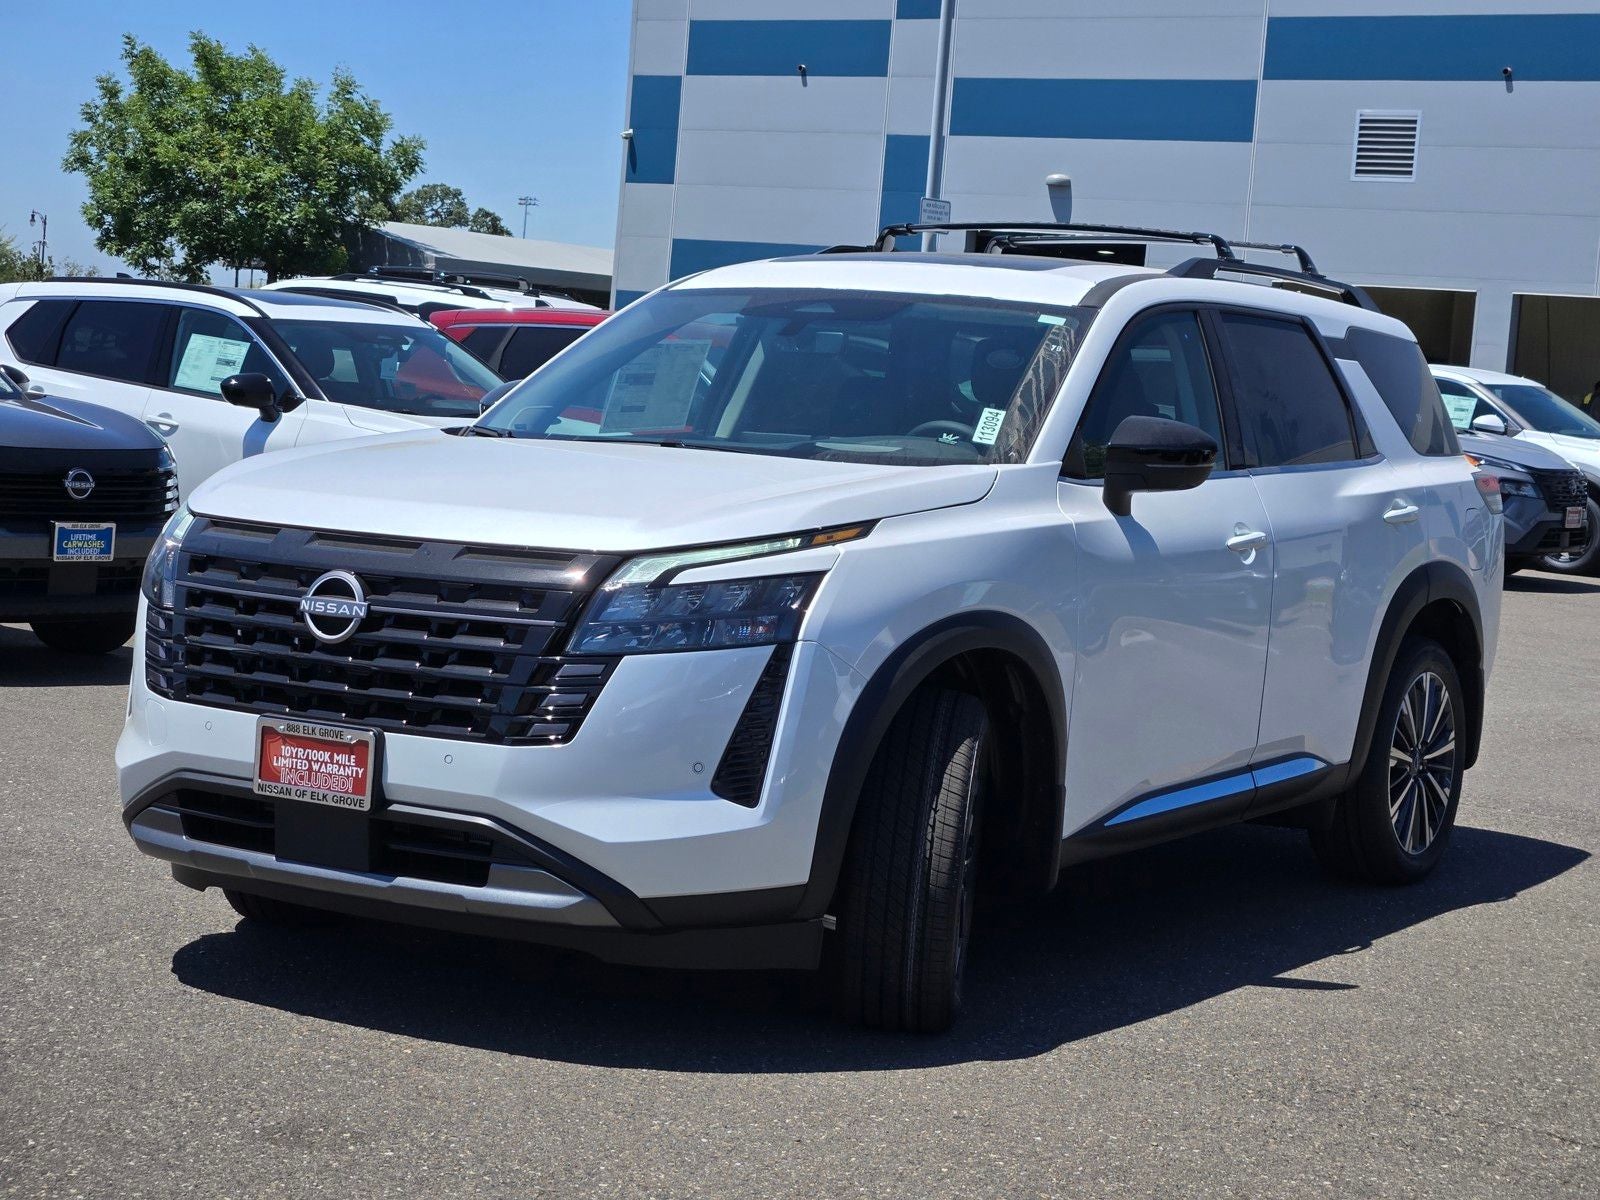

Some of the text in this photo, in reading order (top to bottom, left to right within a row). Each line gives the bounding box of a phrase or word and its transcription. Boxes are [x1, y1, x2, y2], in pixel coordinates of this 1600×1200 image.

[978, 410, 1002, 441] 113094
[62, 540, 105, 548] CARWASHES
[70, 533, 97, 541] LIFETIME
[67, 547, 101, 555] INCLUDED!
[300, 599, 365, 616] NISSAN
[286, 723, 344, 740] 888 ELK GROVE
[281, 745, 356, 766] 10YR/100K MILE
[273, 756, 364, 778] LIMITED WARRANTY
[280, 767, 353, 793] INCLUDED!
[257, 783, 365, 809] NISSAN OF ELK GROVE
